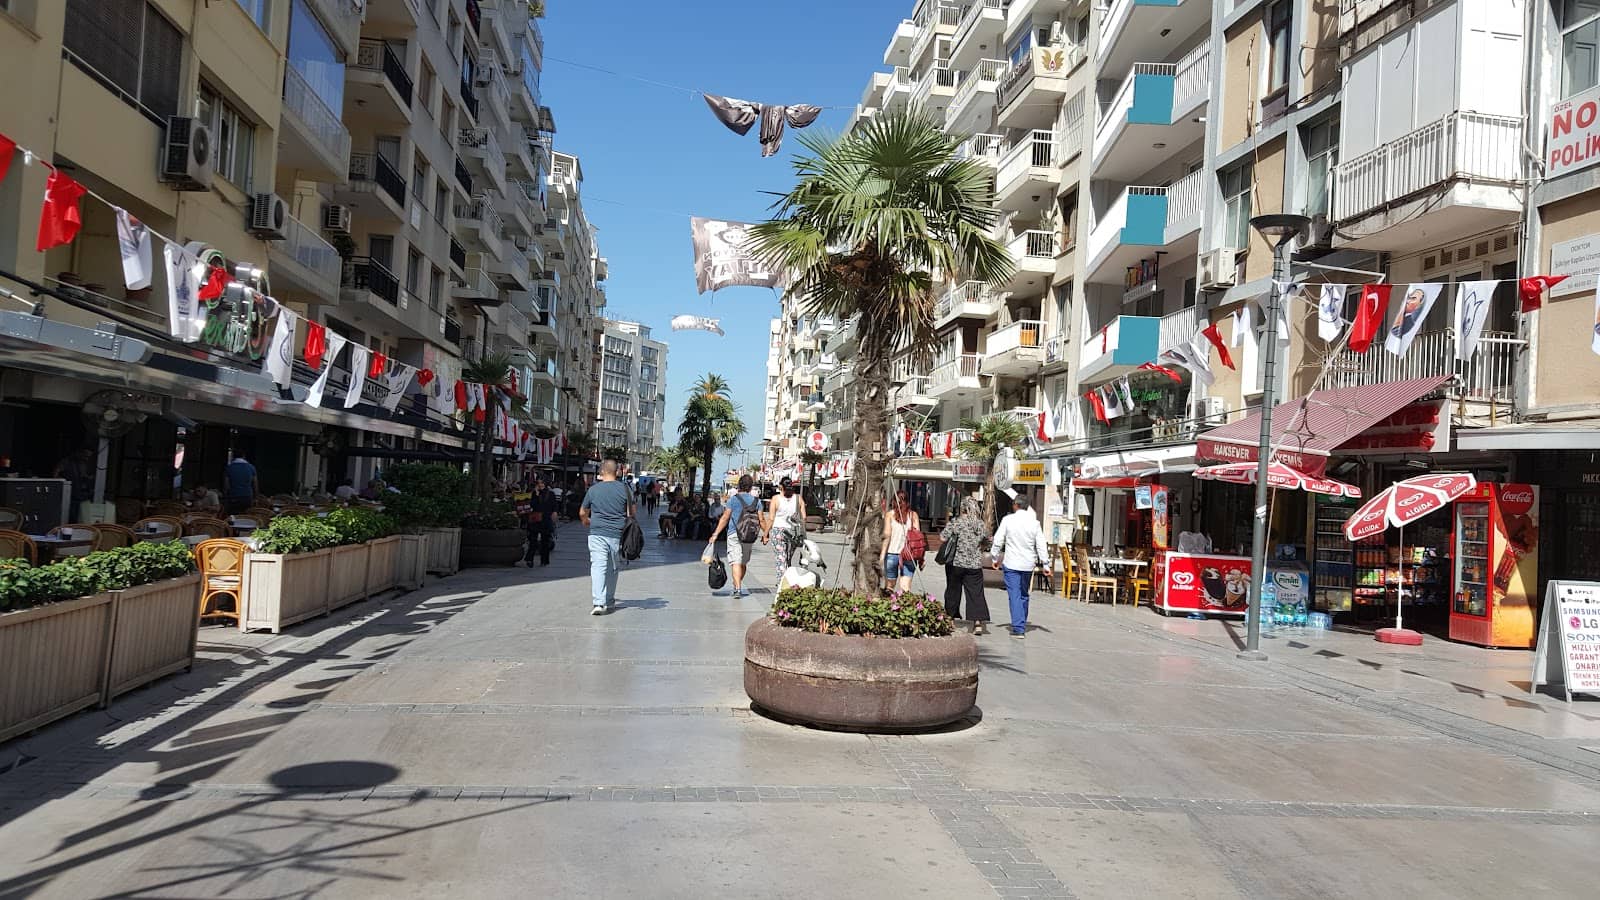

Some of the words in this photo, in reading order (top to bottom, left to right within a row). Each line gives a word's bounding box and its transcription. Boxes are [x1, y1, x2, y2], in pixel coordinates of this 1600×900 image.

[1554, 102, 1573, 113] ÖZEL
[1213, 444, 1250, 460] HAKSEVER
[1267, 475, 1290, 485] LGIDA
[1311, 483, 1336, 492] ALGIDA
[1451, 481, 1467, 496] ALGIDA
[1405, 501, 1433, 518] ALGIDA
[1357, 524, 1380, 535] ALGIDA
[1583, 618, 1599, 629] LG
